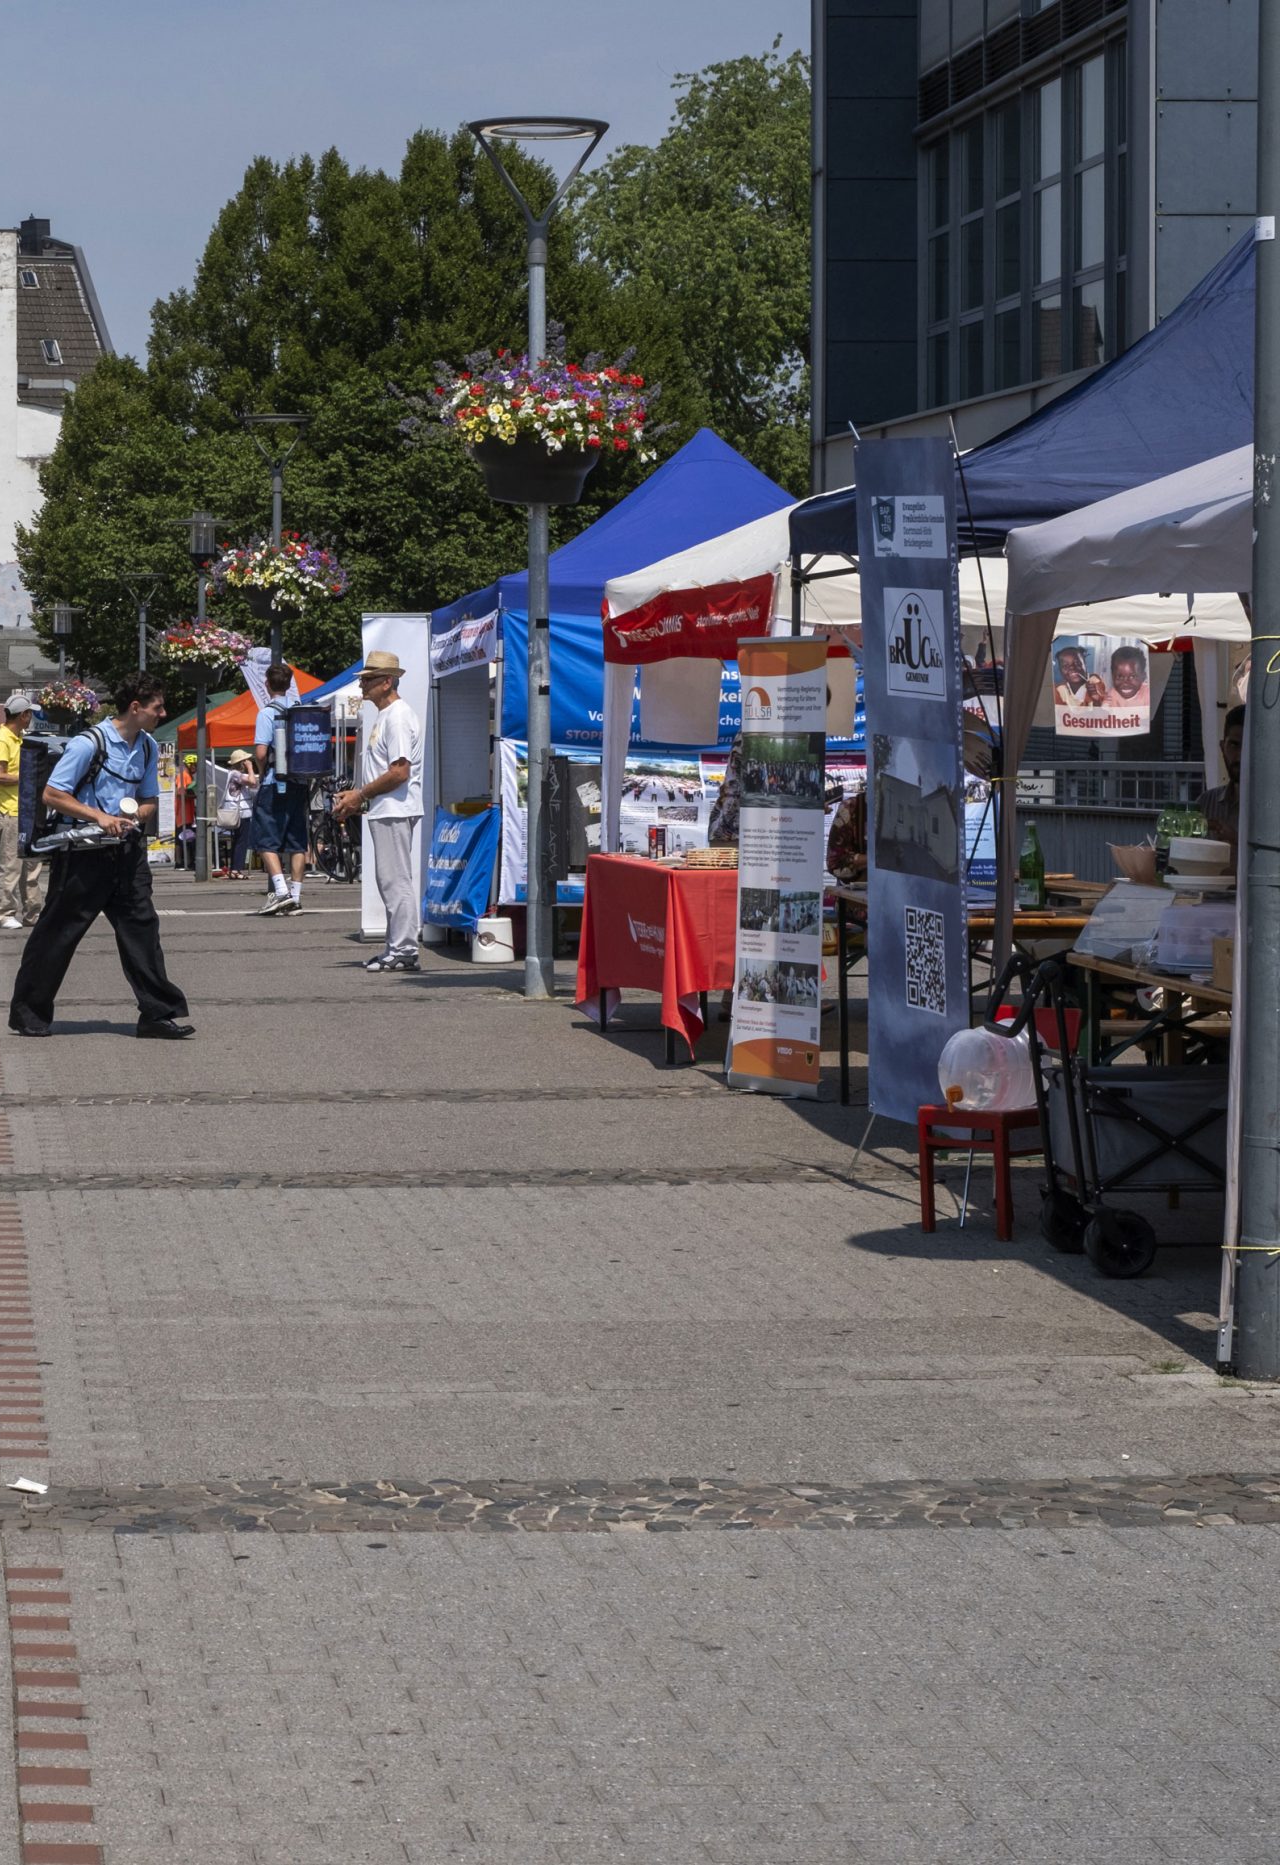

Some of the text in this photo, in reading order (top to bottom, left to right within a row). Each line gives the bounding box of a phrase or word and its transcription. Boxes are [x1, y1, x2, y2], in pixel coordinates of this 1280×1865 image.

[888, 603, 943, 670] BRÜCKEN
[588, 710, 604, 722] Vo
[1062, 712, 1140, 728] Gesundheit
[294, 722, 320, 732] Herbe
